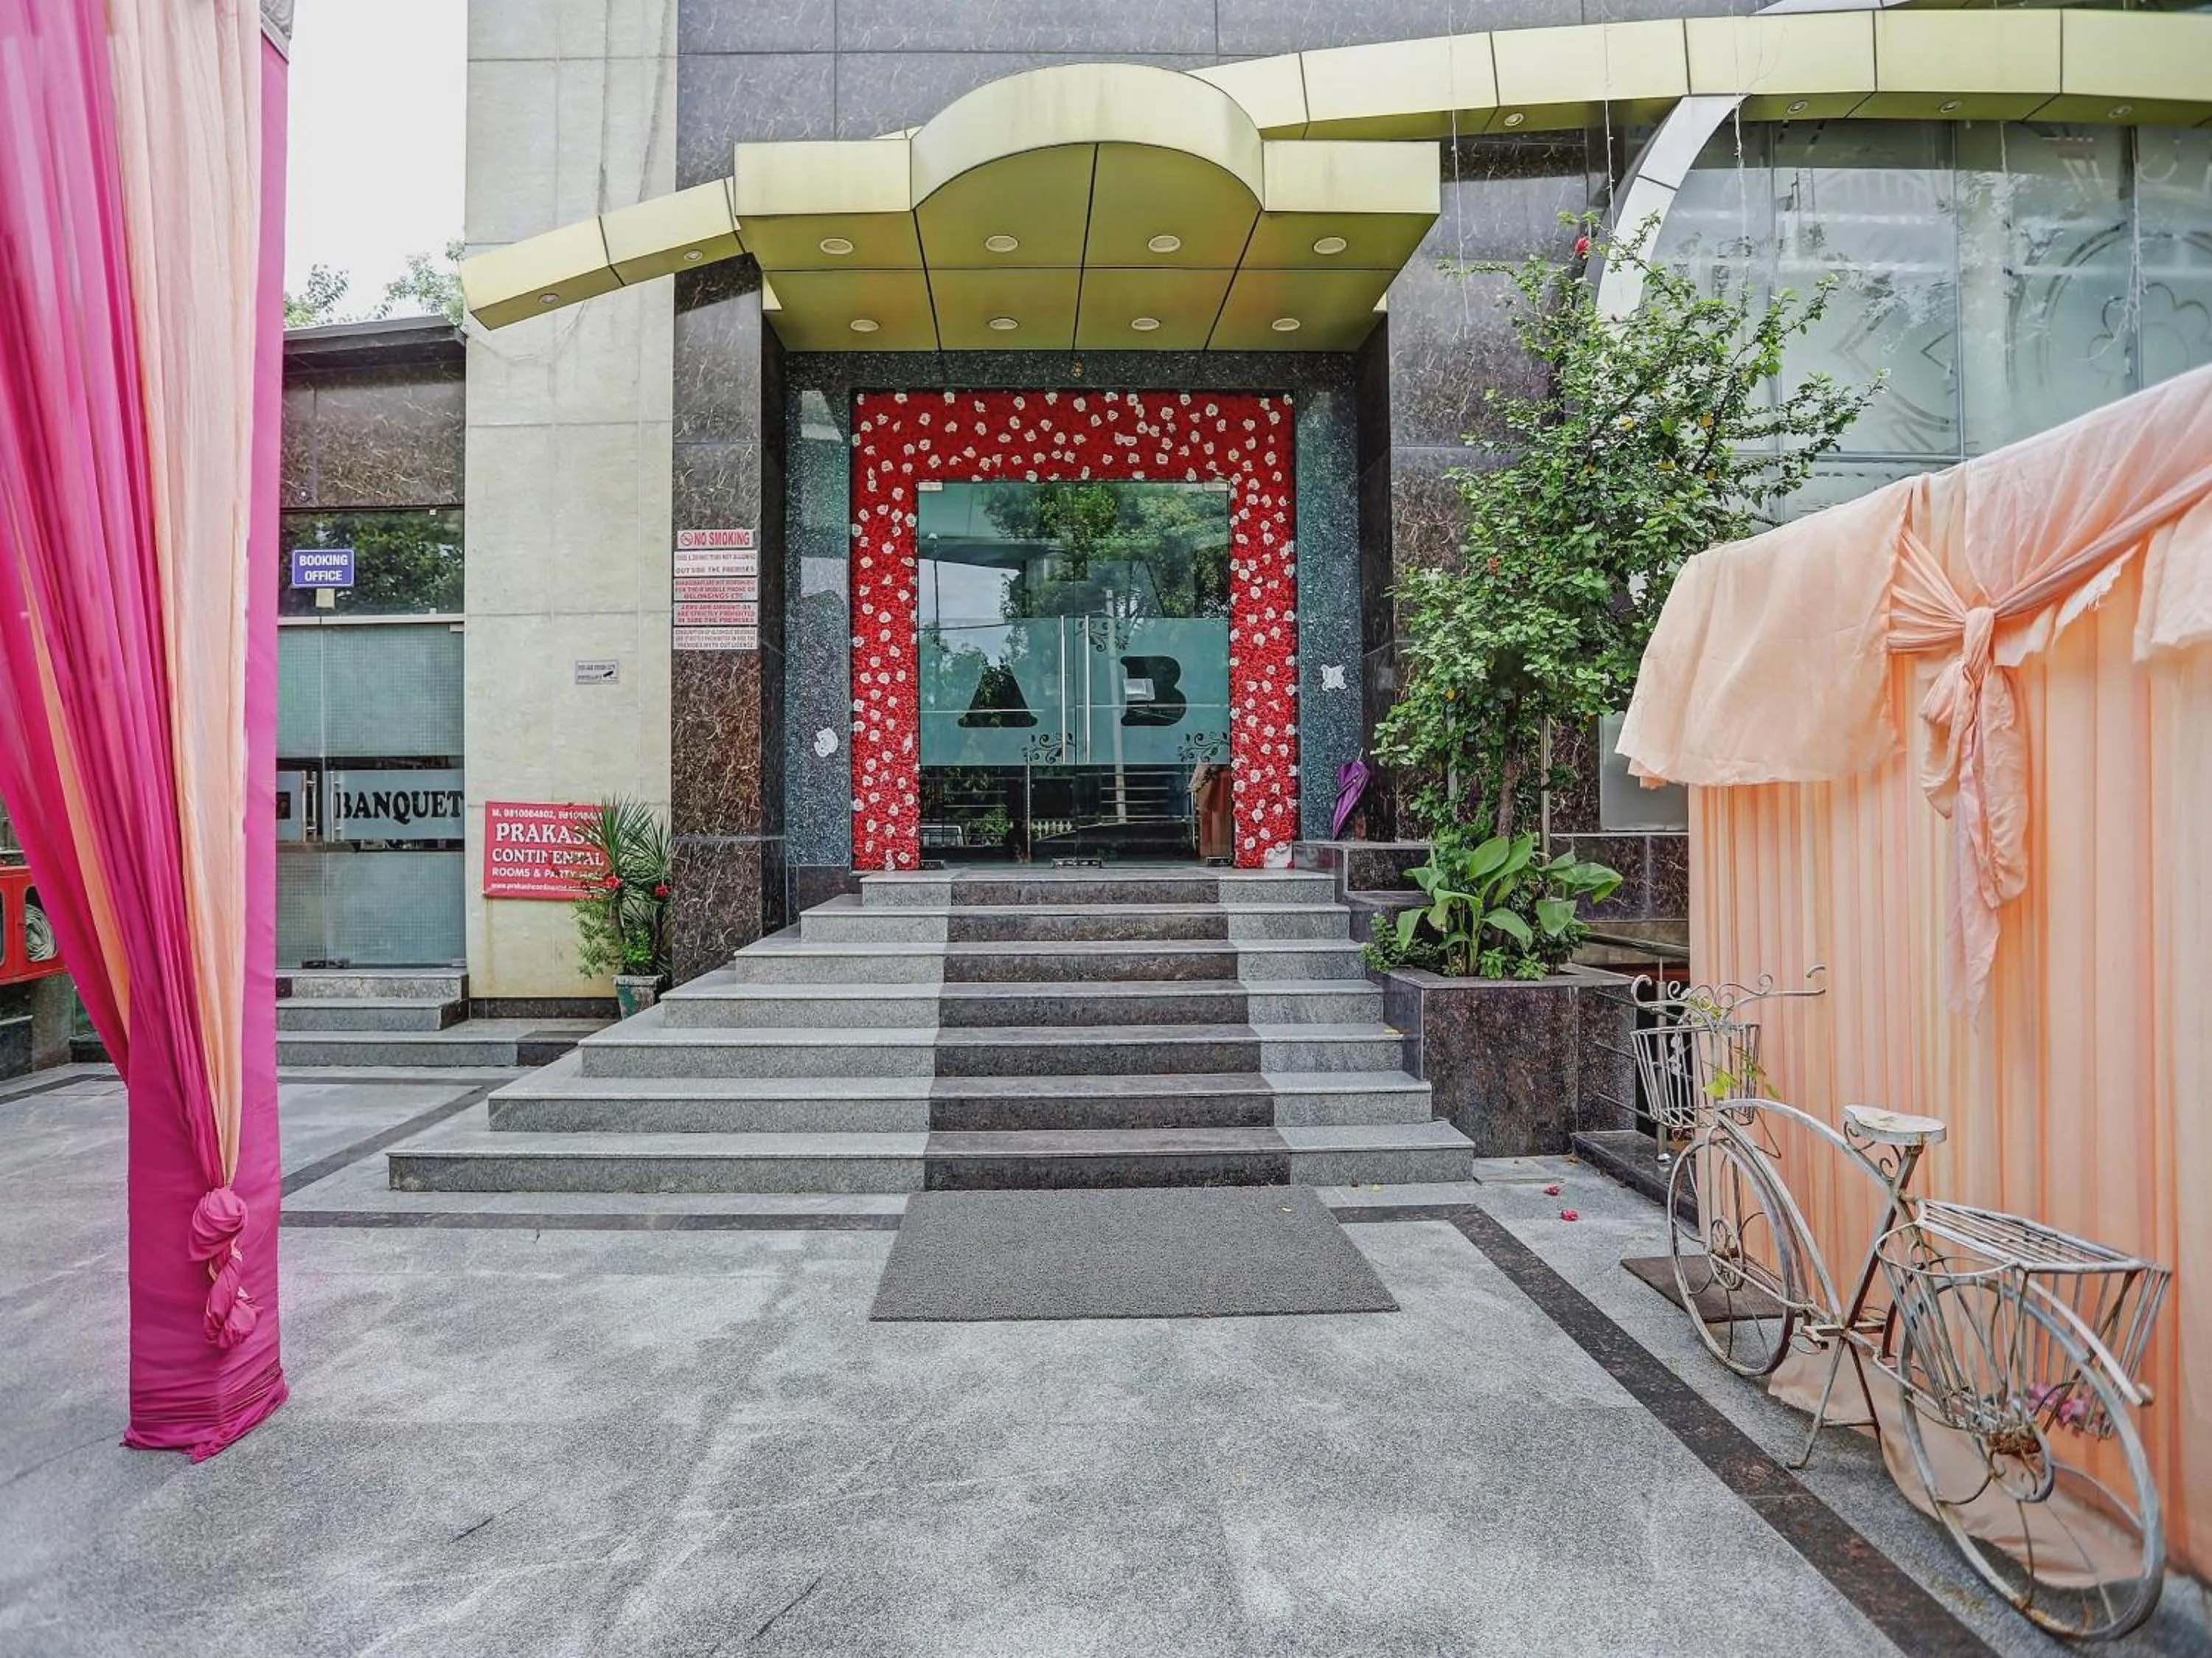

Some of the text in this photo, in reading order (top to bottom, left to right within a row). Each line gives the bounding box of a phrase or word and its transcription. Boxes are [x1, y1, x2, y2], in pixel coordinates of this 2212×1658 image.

[693, 531, 750, 546] NO SMOKING
[299, 554, 349, 566] BOOKING
[305, 569, 343, 582] OFFICE
[335, 789, 465, 825] BANQUET
[492, 867, 530, 877] ROOMS
[533, 869, 542, 878] &
